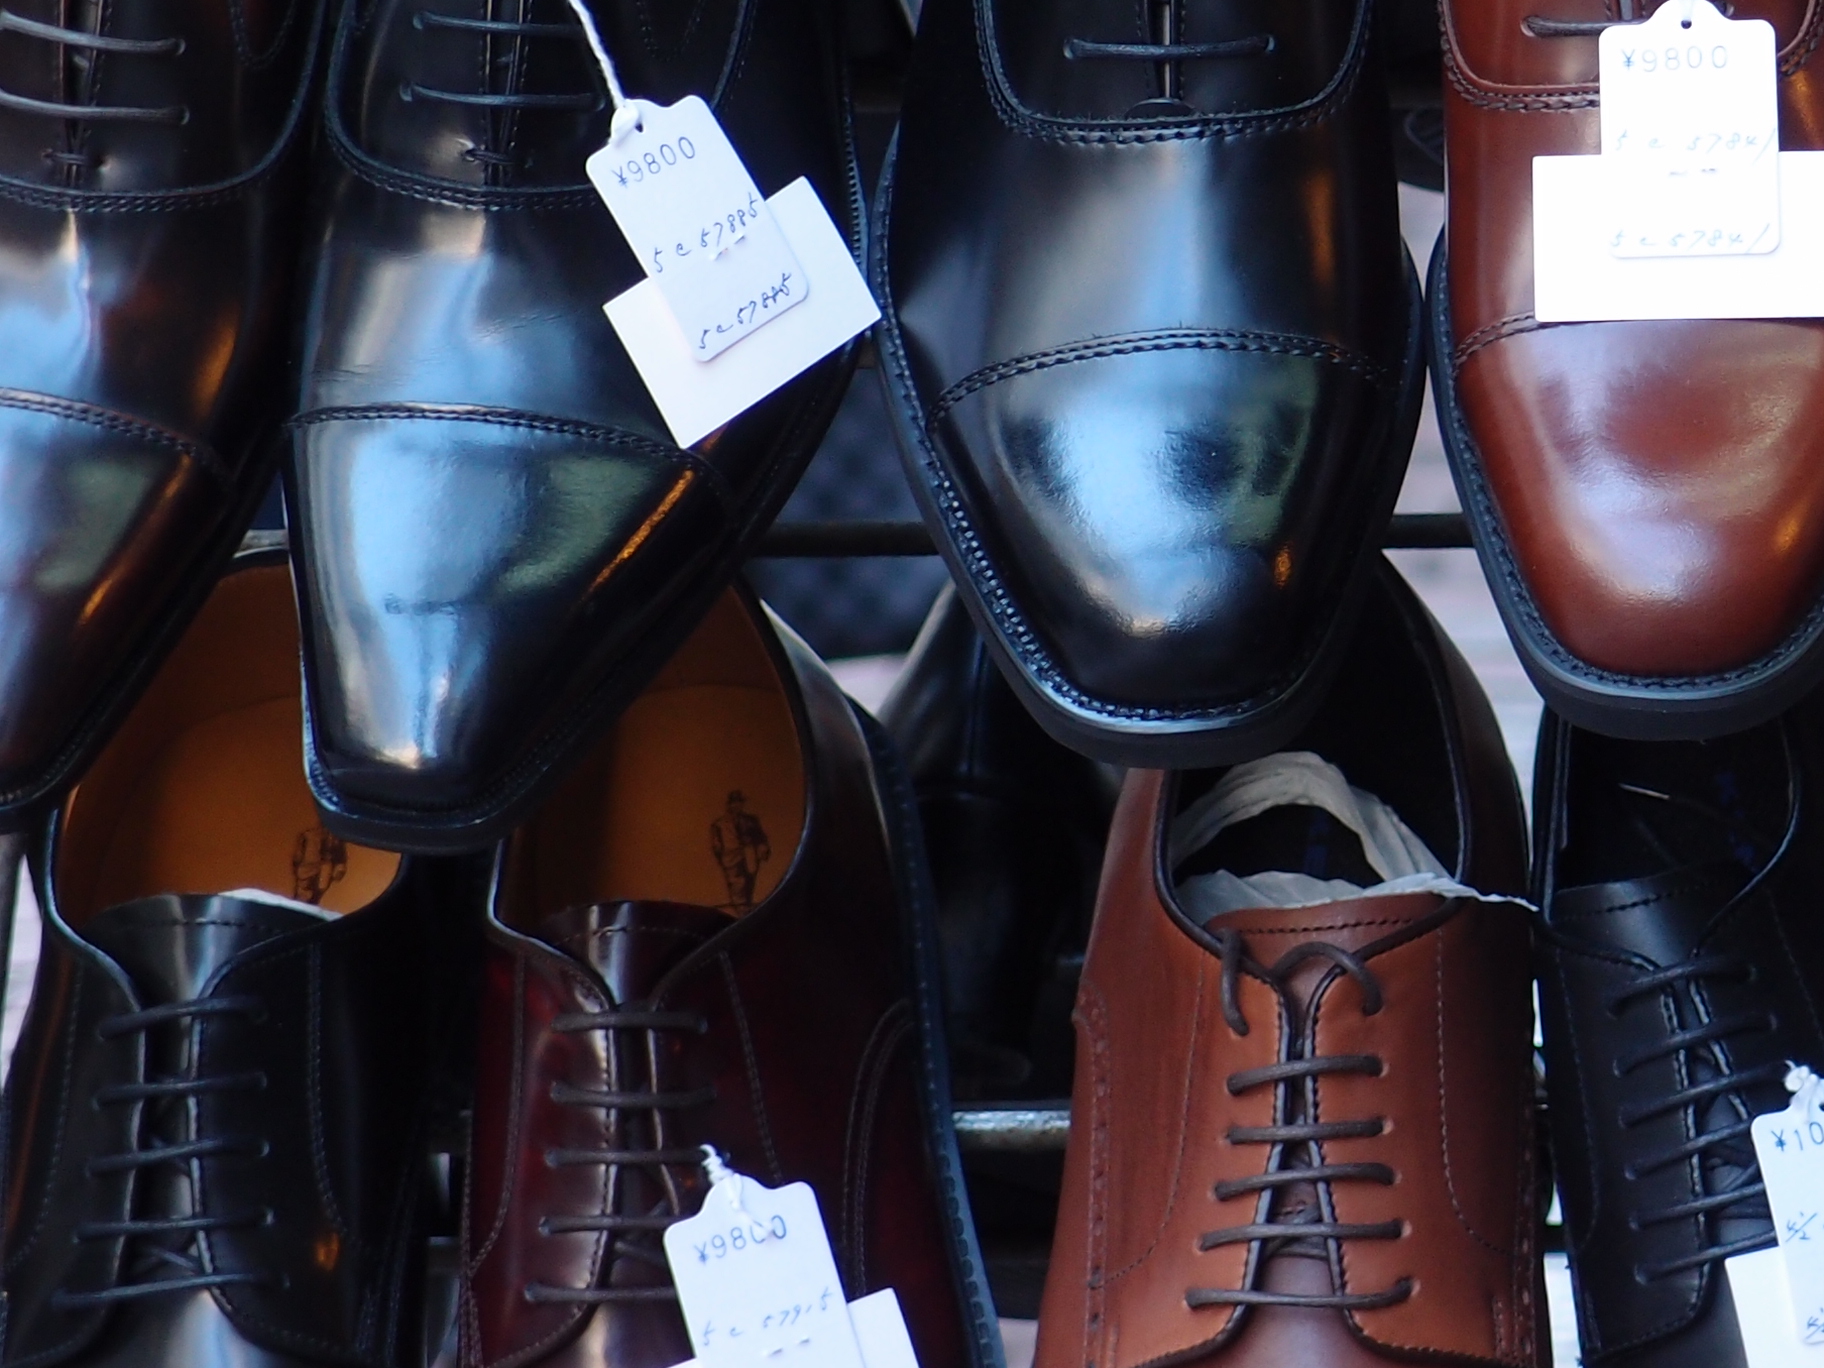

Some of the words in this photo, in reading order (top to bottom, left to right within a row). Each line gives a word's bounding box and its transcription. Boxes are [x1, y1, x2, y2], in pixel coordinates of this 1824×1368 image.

[1621, 45, 1728, 72] ¥9800
[611, 136, 696, 189] ¥9800
[694, 1214, 787, 1265] ¥9800
